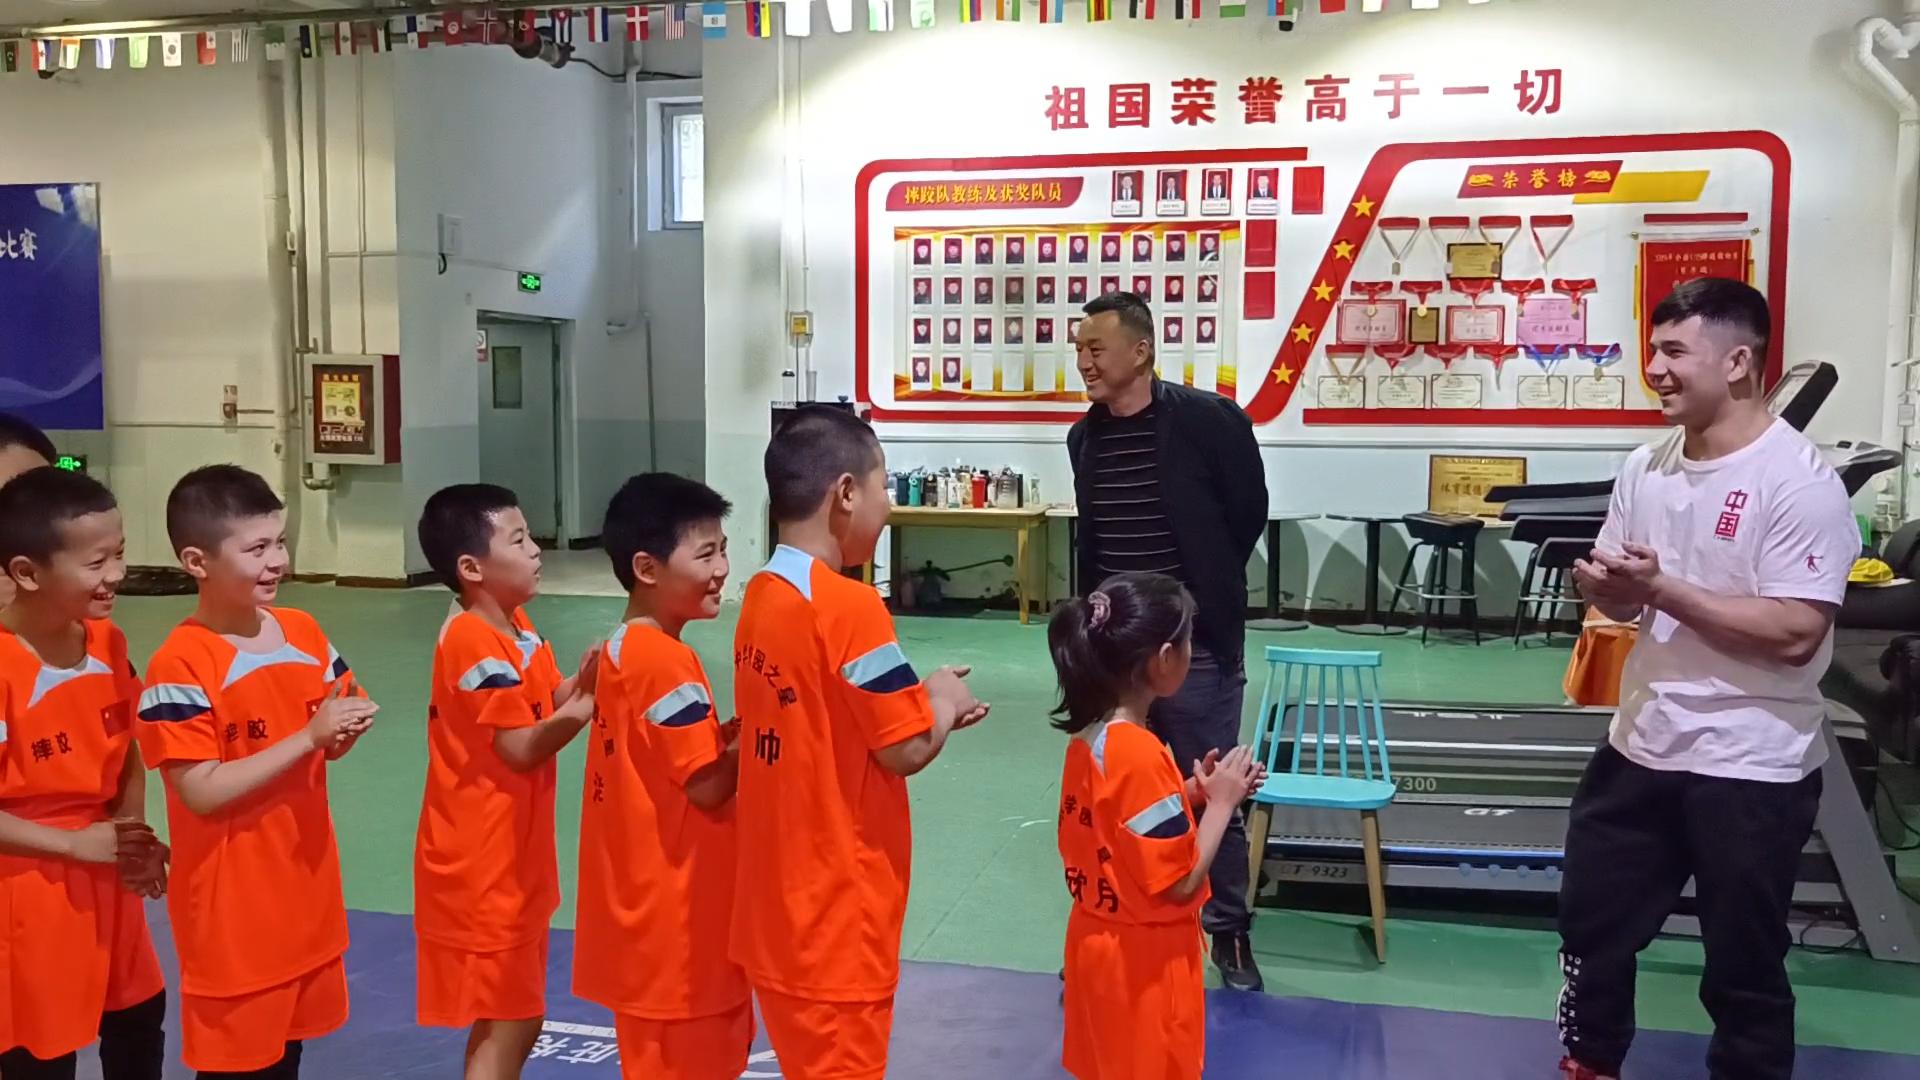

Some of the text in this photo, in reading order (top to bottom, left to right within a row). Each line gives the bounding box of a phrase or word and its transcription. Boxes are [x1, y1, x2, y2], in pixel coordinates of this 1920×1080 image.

[1044, 67, 1563, 131] 祖国荣誉高于一切
[1502, 168, 1577, 190] 荣誉榜
[904, 182, 1062, 205] 摔跤队教练及获奖队员
[1714, 489, 1748, 538] 中国
[31, 731, 72, 763] 摔跤
[1312, 865, 1348, 878] 9323
